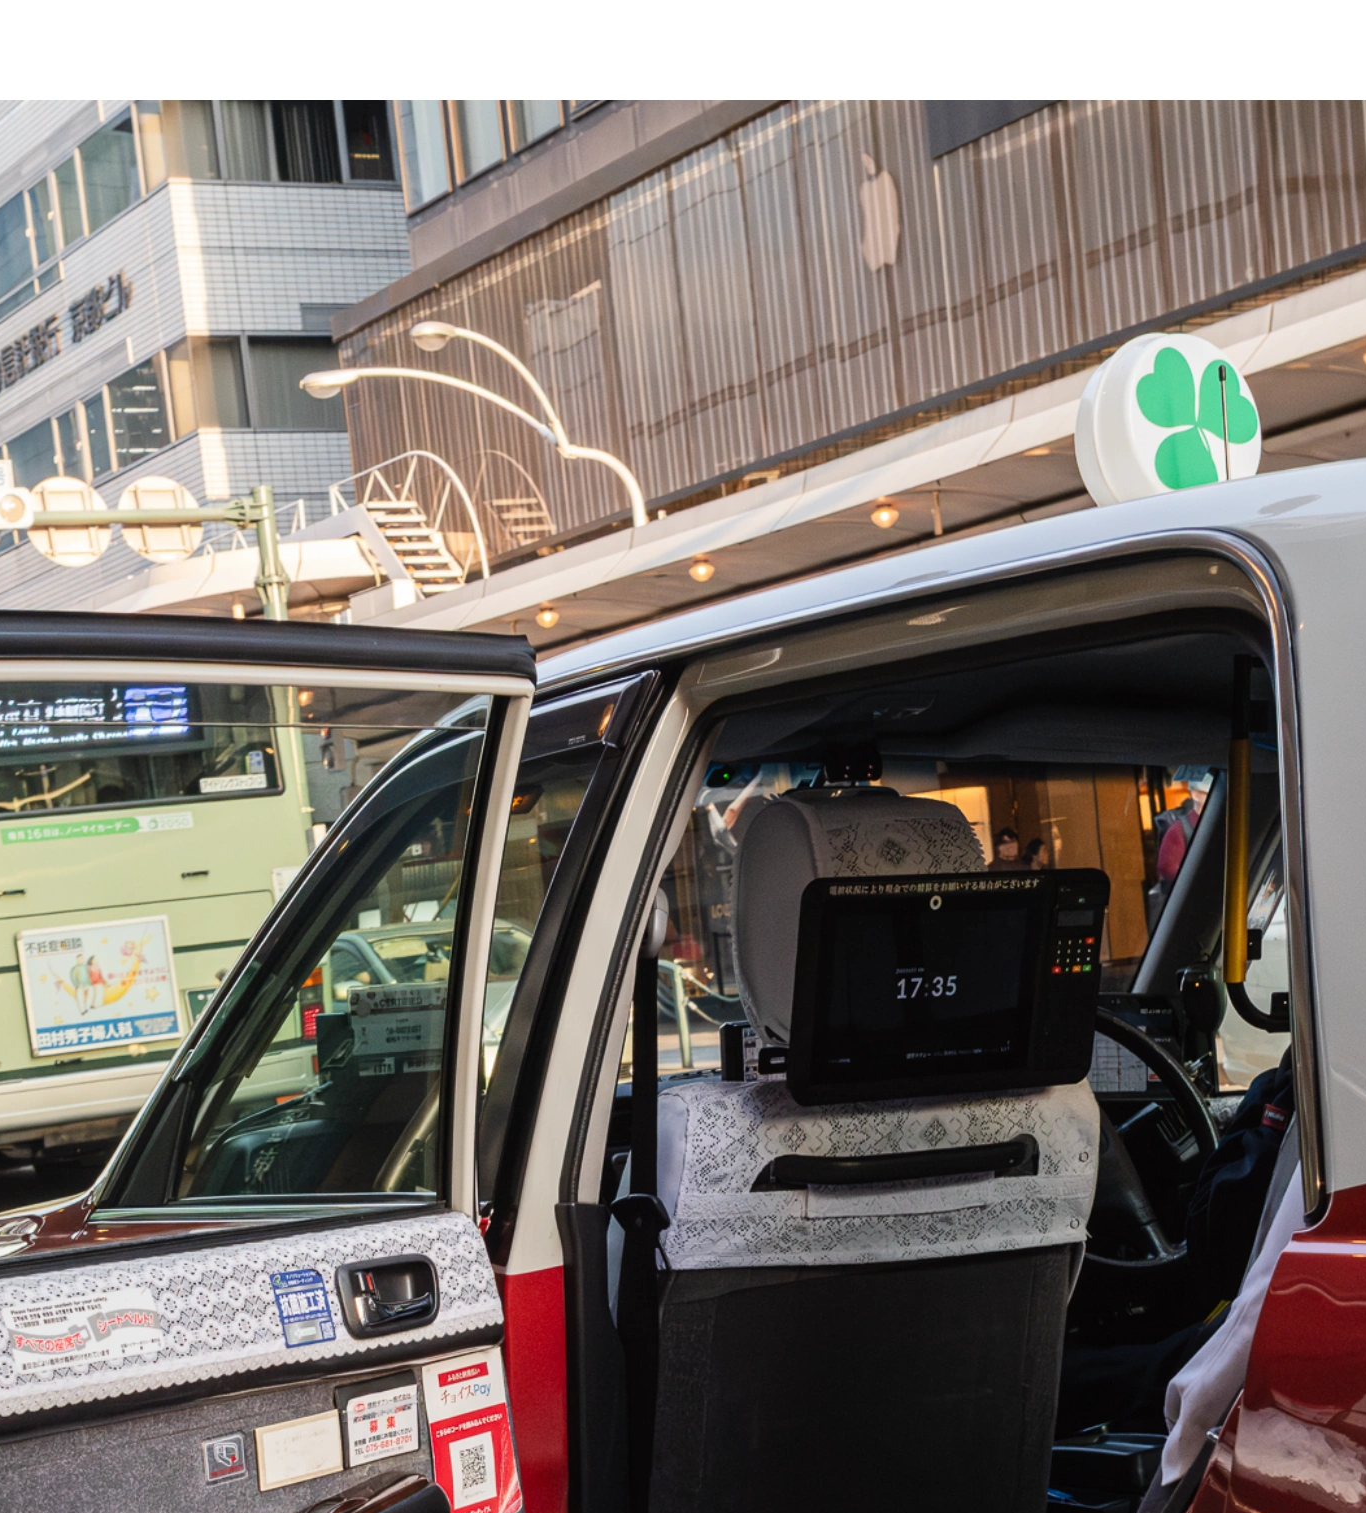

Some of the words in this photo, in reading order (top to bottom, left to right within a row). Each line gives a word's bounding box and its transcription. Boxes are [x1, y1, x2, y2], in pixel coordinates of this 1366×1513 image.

[896, 975, 958, 1000] 17:35
[38, 1021, 134, 1047] 田村秀子婦人科
[97, 1312, 154, 1333] シートベルト!
[15, 1331, 83, 1351] すべての座席で
[441, 1383, 492, 1406] チョイスPay
[355, 1447, 364, 1455] TEL
[365, 1435, 413, 1453] 075-681-8701
